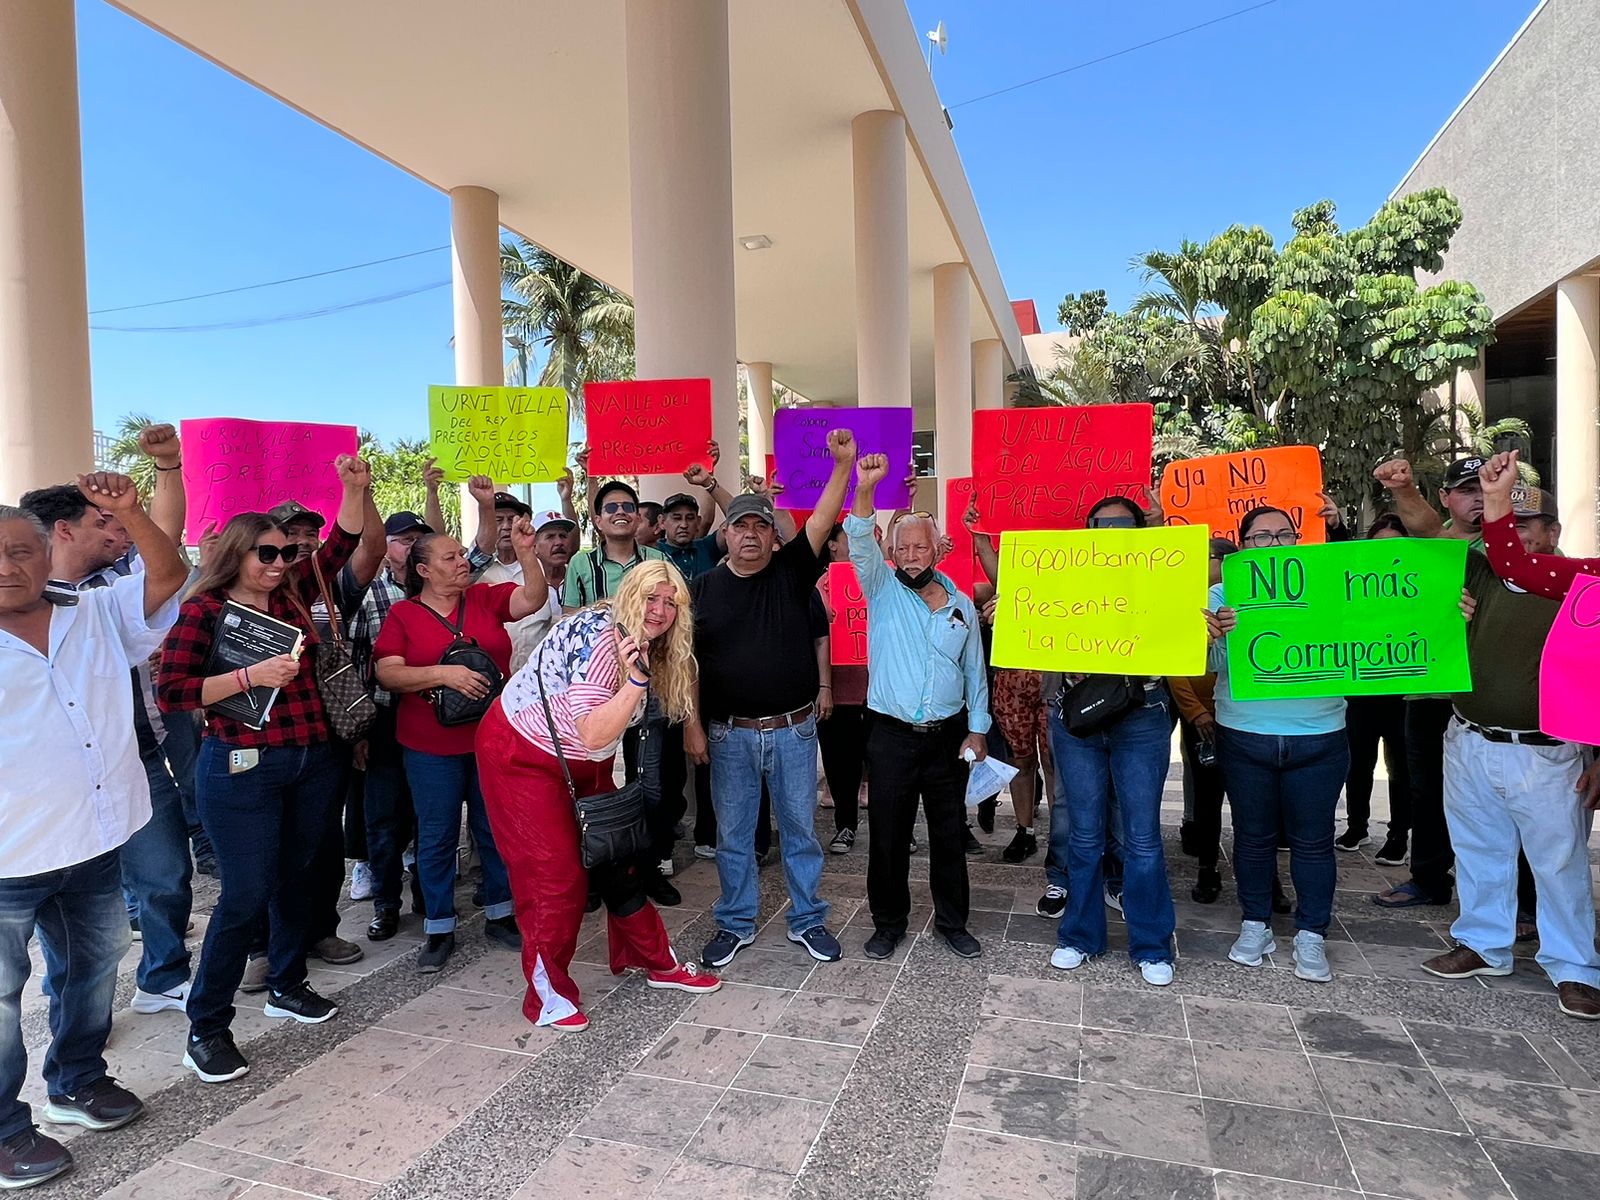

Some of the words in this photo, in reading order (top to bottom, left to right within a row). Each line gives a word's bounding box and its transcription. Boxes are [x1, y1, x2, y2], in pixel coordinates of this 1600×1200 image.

[441, 392, 493, 413] URVI
[506, 394, 563, 416] VILLA
[591, 394, 653, 415] VALLE
[661, 393, 689, 408] DEL
[451, 417, 472, 428] DEL
[486, 415, 509, 426] REY
[620, 414, 671, 429] AGUA
[998, 410, 1090, 447] VALLE
[434, 429, 498, 444] PRECENTE
[508, 430, 539, 442] LOS
[455, 443, 537, 460] MOCHIS
[602, 440, 687, 460] PRESENTE
[996, 453, 1040, 475] DEL
[1056, 447, 1134, 476] AGUA
[204, 460, 341, 491] PRECENT
[453, 459, 550, 479] SINALOA
[1228, 457, 1267, 488] NO
[1002, 537, 1186, 576] Topolobampo
[1243, 556, 1305, 602] NO
[1344, 558, 1420, 602] más
[1247, 631, 1437, 682] Corrupción.
